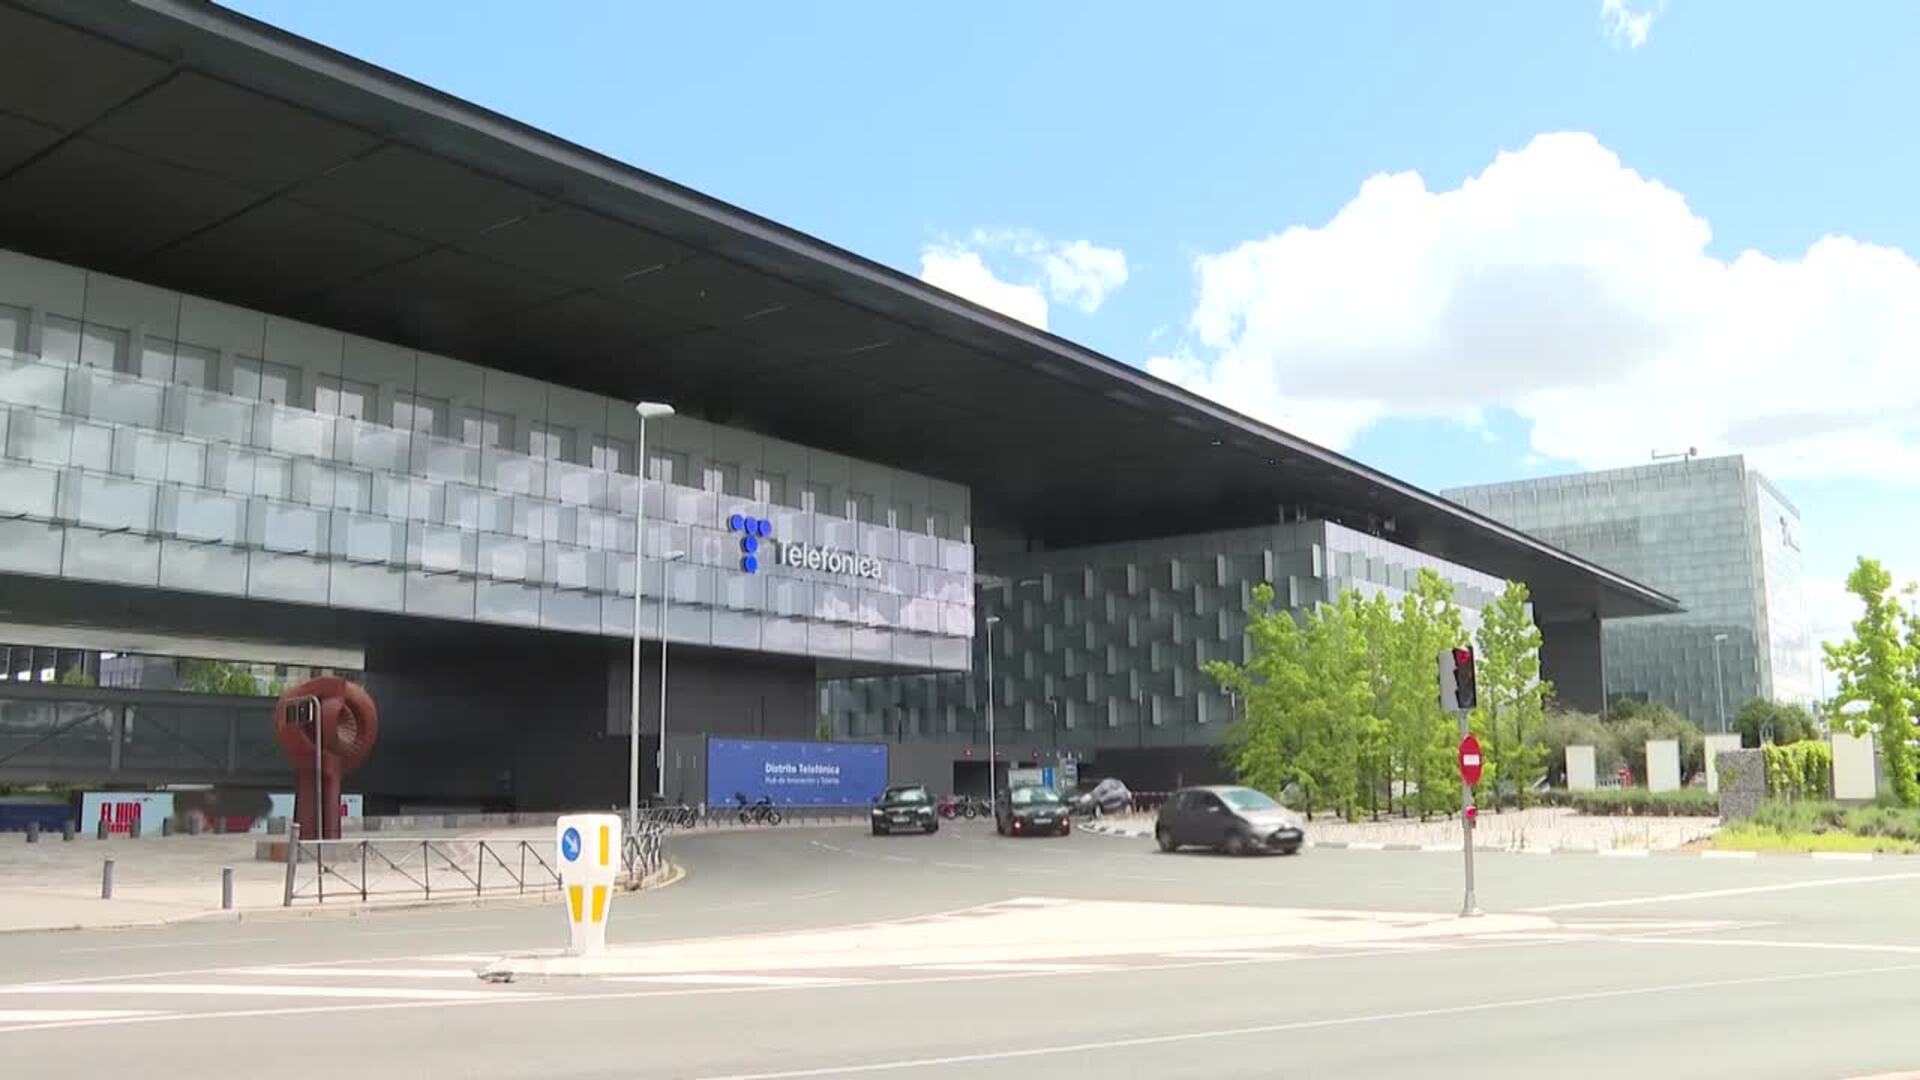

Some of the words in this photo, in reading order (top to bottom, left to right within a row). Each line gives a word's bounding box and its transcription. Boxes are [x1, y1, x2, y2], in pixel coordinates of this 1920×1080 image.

[778, 541, 882, 578] Telefónica
[765, 762, 797, 773] Distrito
[799, 763, 840, 775] Telefónica
